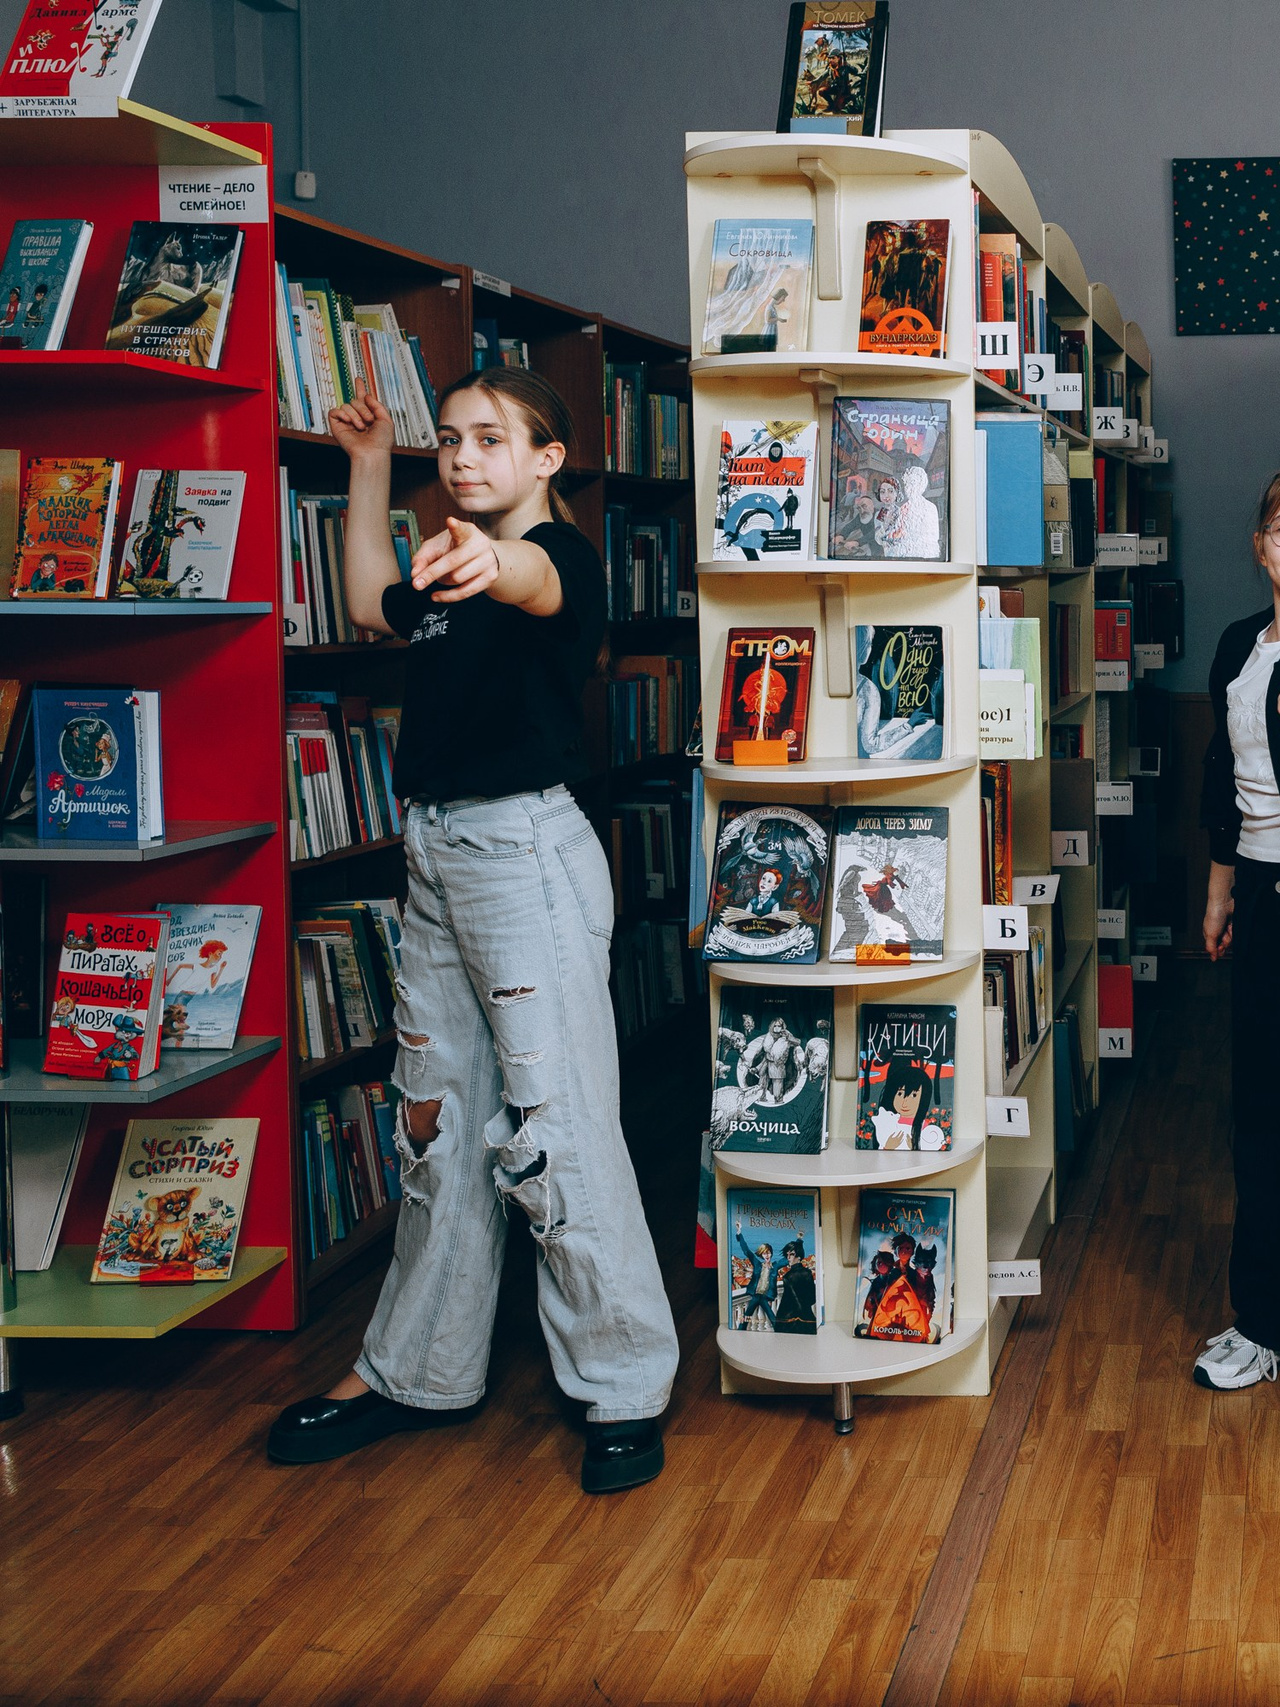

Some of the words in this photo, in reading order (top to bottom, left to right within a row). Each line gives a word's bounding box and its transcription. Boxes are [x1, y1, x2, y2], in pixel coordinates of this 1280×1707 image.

[30, 8, 87, 19] Даниил
[814, 11, 866, 23] ТОМЕК
[14, 98, 77, 106] ЗАРУБЕЖНАЯ
[14, 108, 76, 117] ЛИТЕРАТУРА
[168, 183, 211, 194] ЧТЕНИЕ
[223, 182, 255, 195] ДЕЛО
[179, 199, 246, 212] СЕМЕЙНОЕ!
[120, 325, 208, 336] ПУТЕШЕСТВИЕ
[133, 336, 140, 345] В
[144, 337, 190, 347] СТРАНУ
[869, 333, 938, 344] ВУНДЕРКИДЗ
[980, 334, 1009, 355] Ш
[126, 347, 191, 358] СФИНКСОВ
[1027, 364, 1044, 383] Э
[1063, 384, 1080, 392] Н.В.
[848, 408, 940, 428] Страница
[1096, 415, 1116, 430] Ж
[866, 428, 918, 441] один
[728, 475, 748, 486] на
[753, 475, 804, 486] пляже
[184, 486, 218, 497] Заявка
[220, 488, 232, 497] на
[197, 497, 231, 508] подвиг
[681, 597, 691, 610] В
[86, 785, 127, 802] Мадам
[1114, 794, 1131, 802] М.Ю.
[48, 789, 131, 825] Артишок
[855, 817, 882, 831] ДОРОГА
[884, 817, 906, 830] ЧЕРЕЗ
[908, 817, 933, 831] ЗИМУ
[1063, 838, 1080, 858] Д
[1030, 883, 1046, 897] В
[101, 922, 133, 943] ВСЁ
[998, 918, 1017, 938] Б
[1139, 962, 1149, 975] Р
[73, 1007, 113, 1029] МОРЯ
[868, 1022, 947, 1062] КАТИЦИ
[1108, 1036, 1125, 1050] М
[1005, 1108, 1018, 1123] Г
[729, 1120, 800, 1135] ВОЛЧИЦА
[142, 1136, 235, 1159] УСАТЫЙ
[129, 1156, 240, 1179] СЮРПРИЗ
[1018, 1270, 1039, 1278] А.С.
[873, 1326, 923, 1337] КОРОЛЬ-ВОЛК
